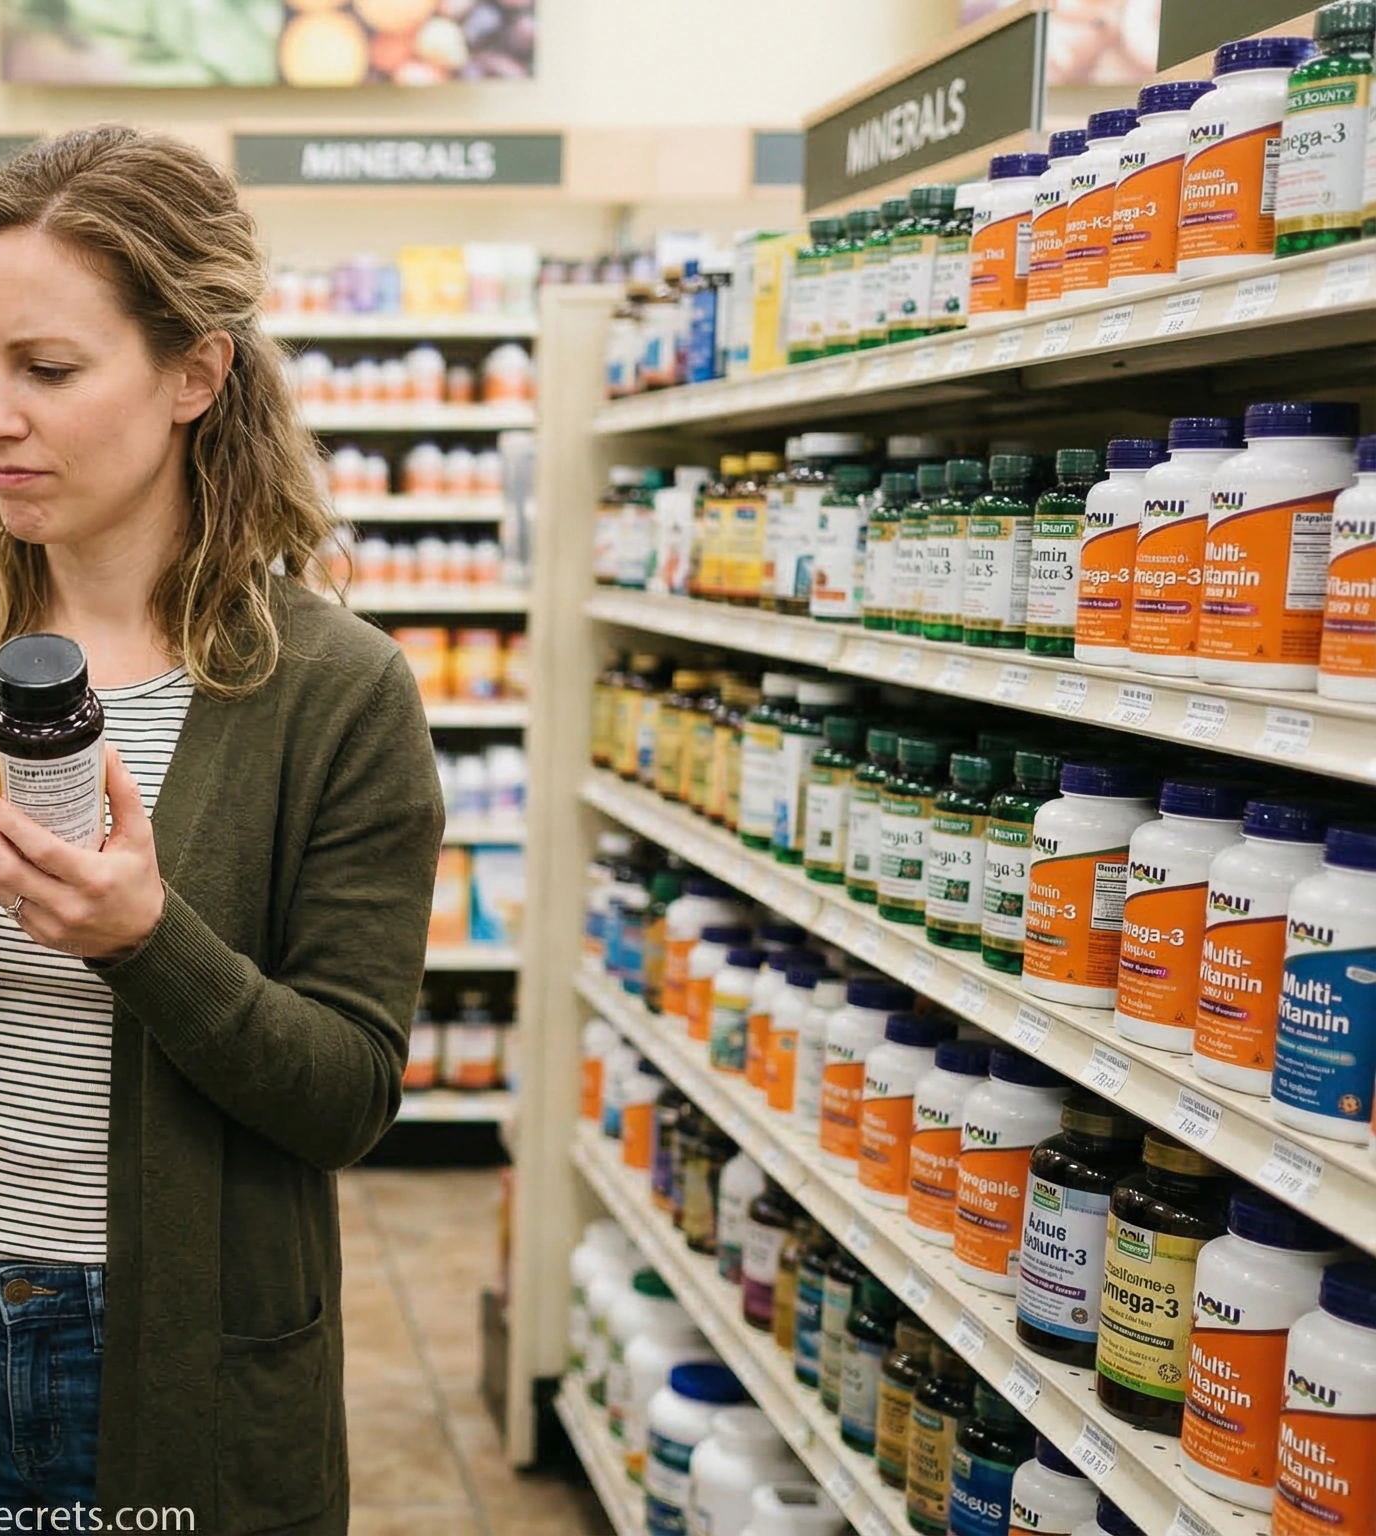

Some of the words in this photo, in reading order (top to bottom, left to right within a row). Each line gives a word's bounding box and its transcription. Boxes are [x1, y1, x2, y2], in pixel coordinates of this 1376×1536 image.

[845, 78, 967, 178] MINERALS
[301, 140, 495, 180] MINERALS
[1282, 970, 1342, 1004] Multi-
[1191, 1343, 1241, 1380] Multi-
[1187, 1361, 1252, 1409] Vitamin
[1281, 1422, 1336, 1465] Multi-
[1277, 1444, 1350, 1496] Vitamin
